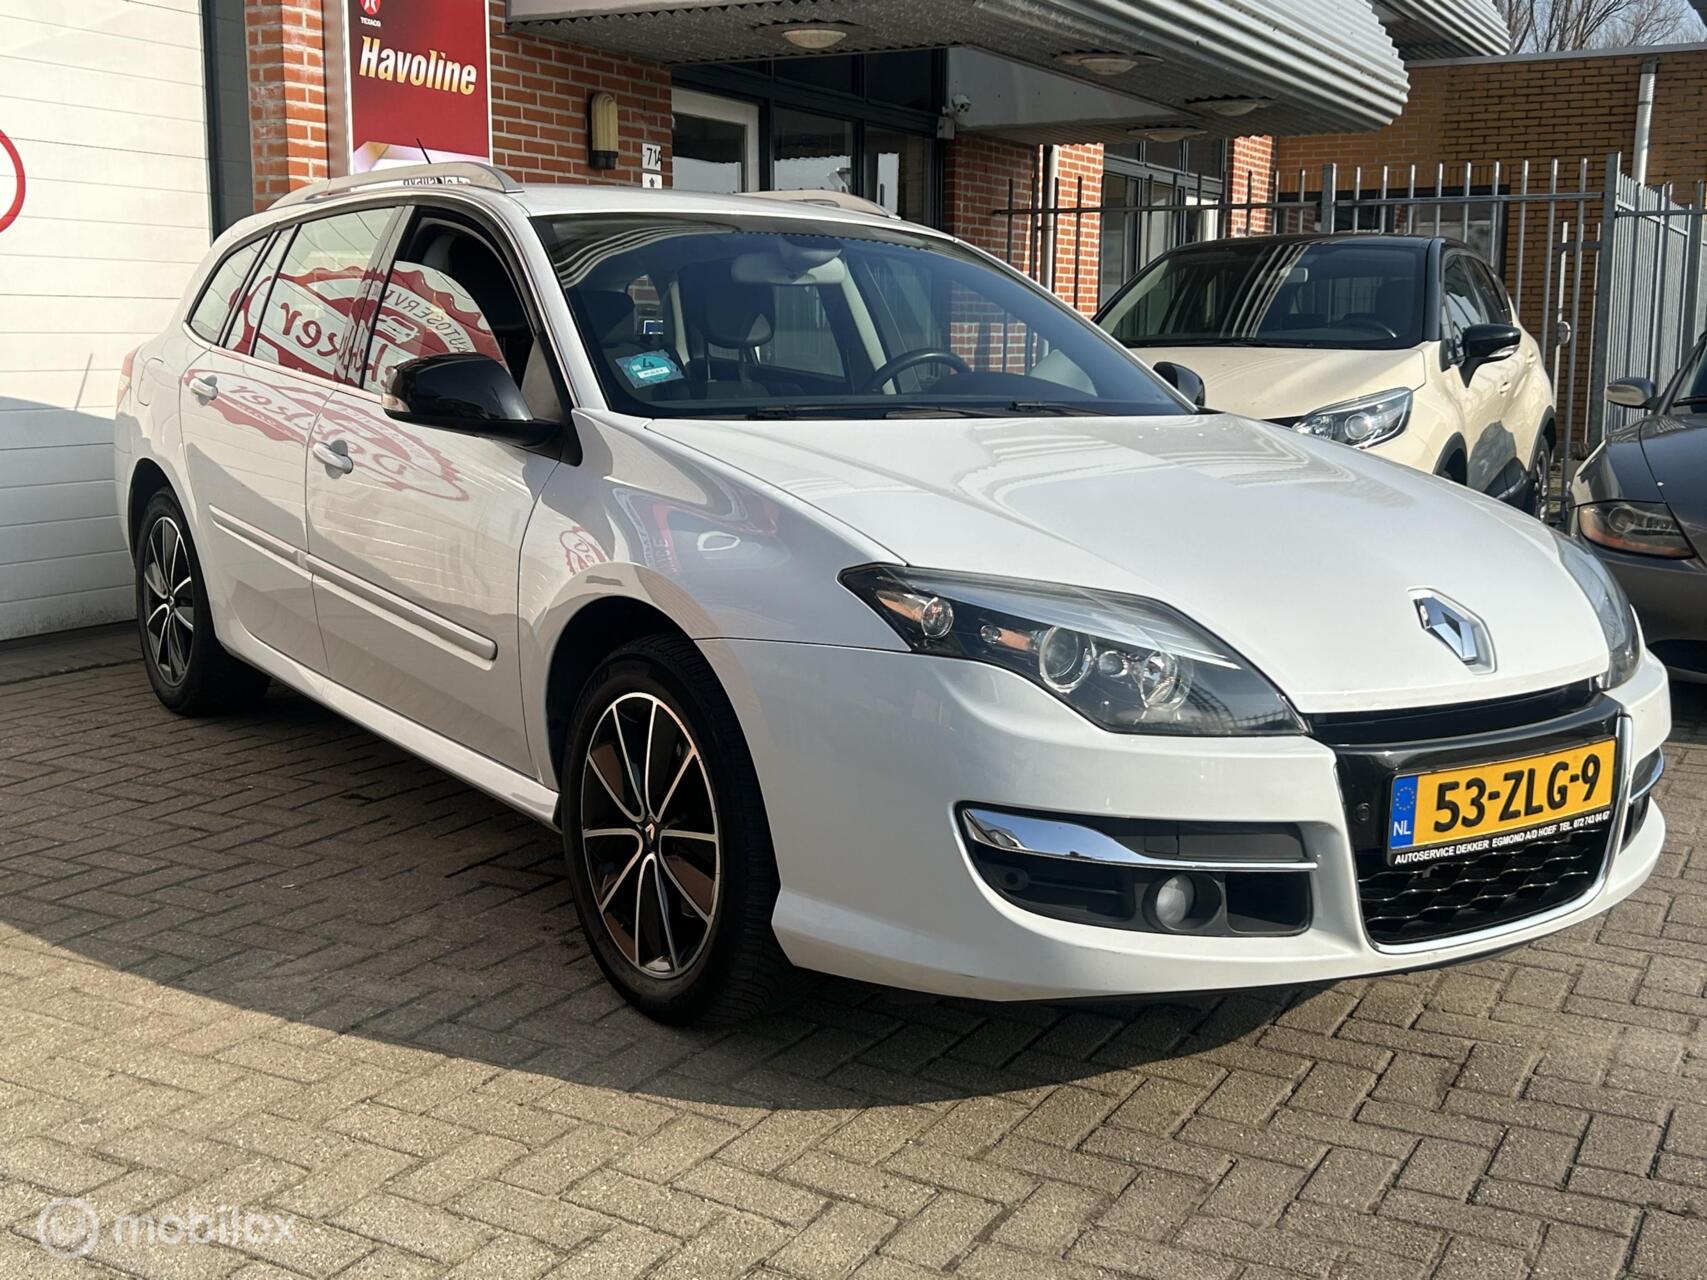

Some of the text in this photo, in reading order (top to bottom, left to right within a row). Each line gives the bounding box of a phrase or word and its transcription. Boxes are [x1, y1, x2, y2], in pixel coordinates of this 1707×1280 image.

[360, 16, 381, 27] TEXACO
[359, 36, 477, 95] Havoline
[1433, 753, 1601, 833] 53-ZLG-9
[1393, 820, 1411, 837] NL
[1394, 846, 1455, 865] AUTOSERVICE
[1455, 839, 1489, 855] DEKKER
[1491, 832, 1525, 848] EGMOND
[1538, 824, 1558, 837] HOEF
